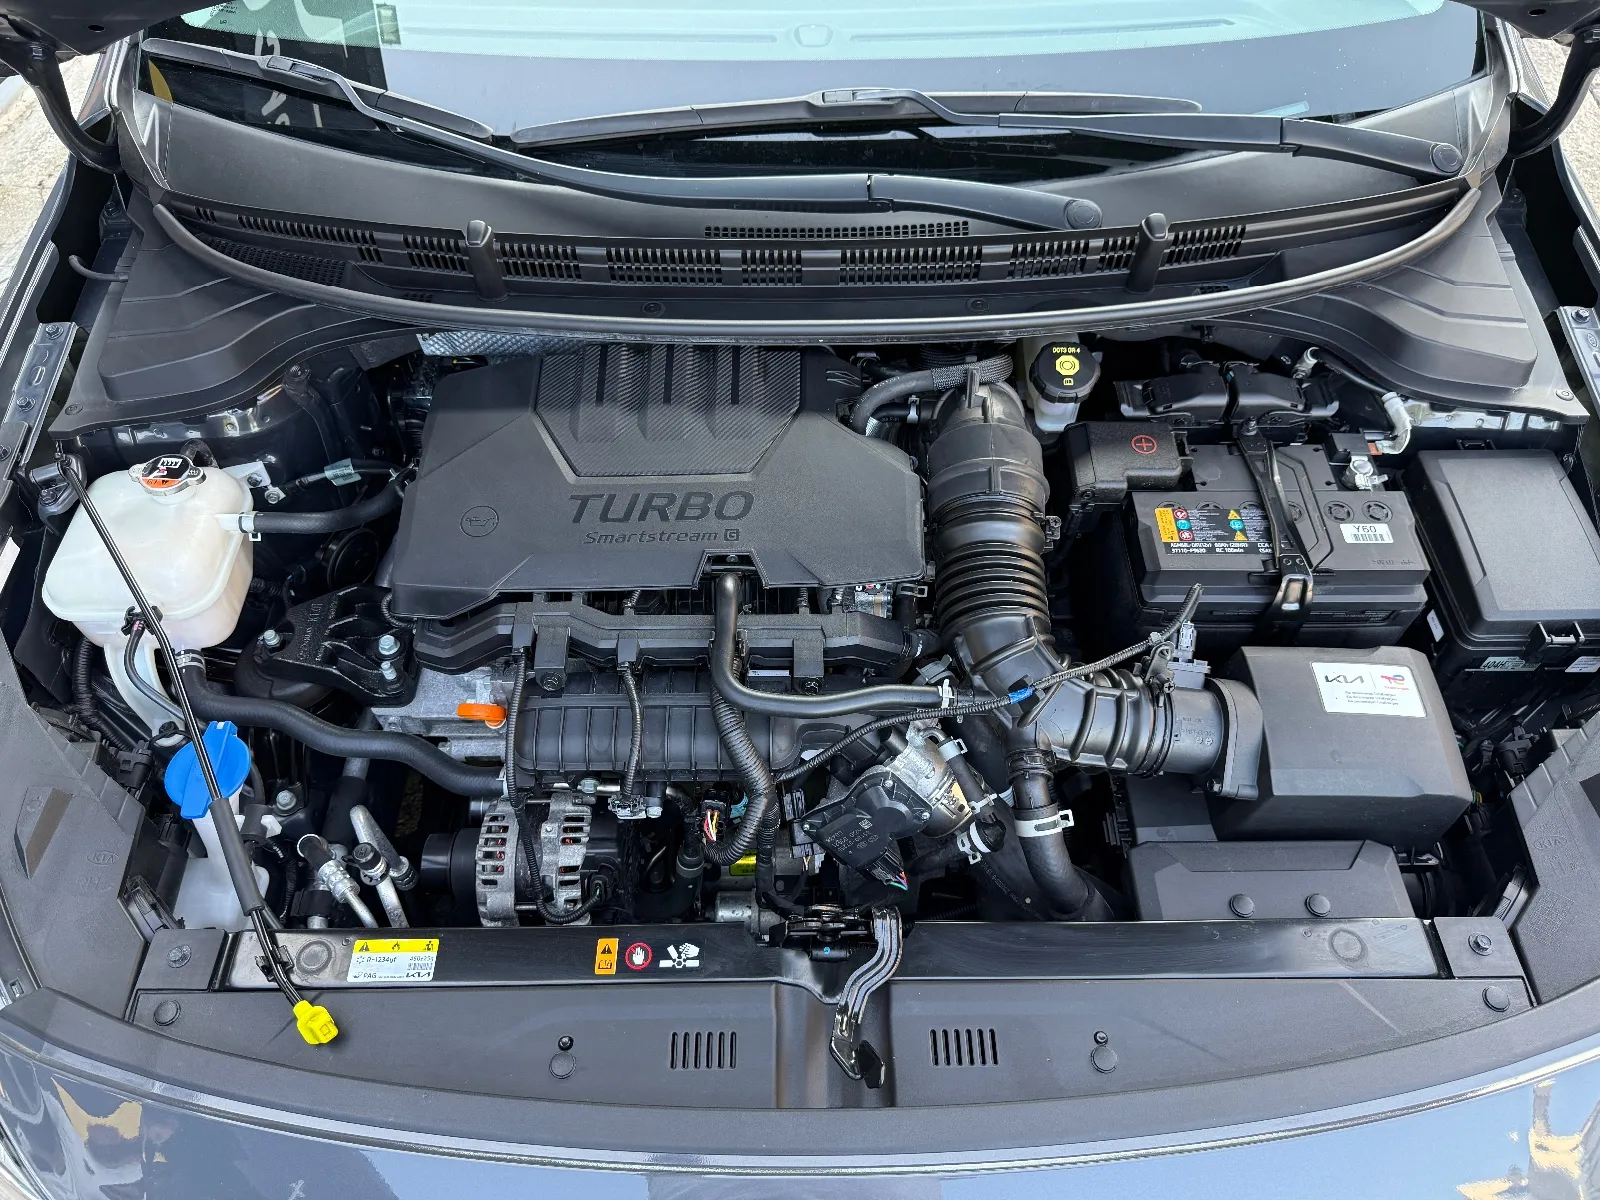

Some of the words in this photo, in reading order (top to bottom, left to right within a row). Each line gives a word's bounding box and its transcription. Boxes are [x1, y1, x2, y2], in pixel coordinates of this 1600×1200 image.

[569, 490, 755, 524] TURBO
[1352, 525, 1377, 533] Y60
[583, 530, 719, 544] Smartstream
[1324, 674, 1365, 684] KIA
